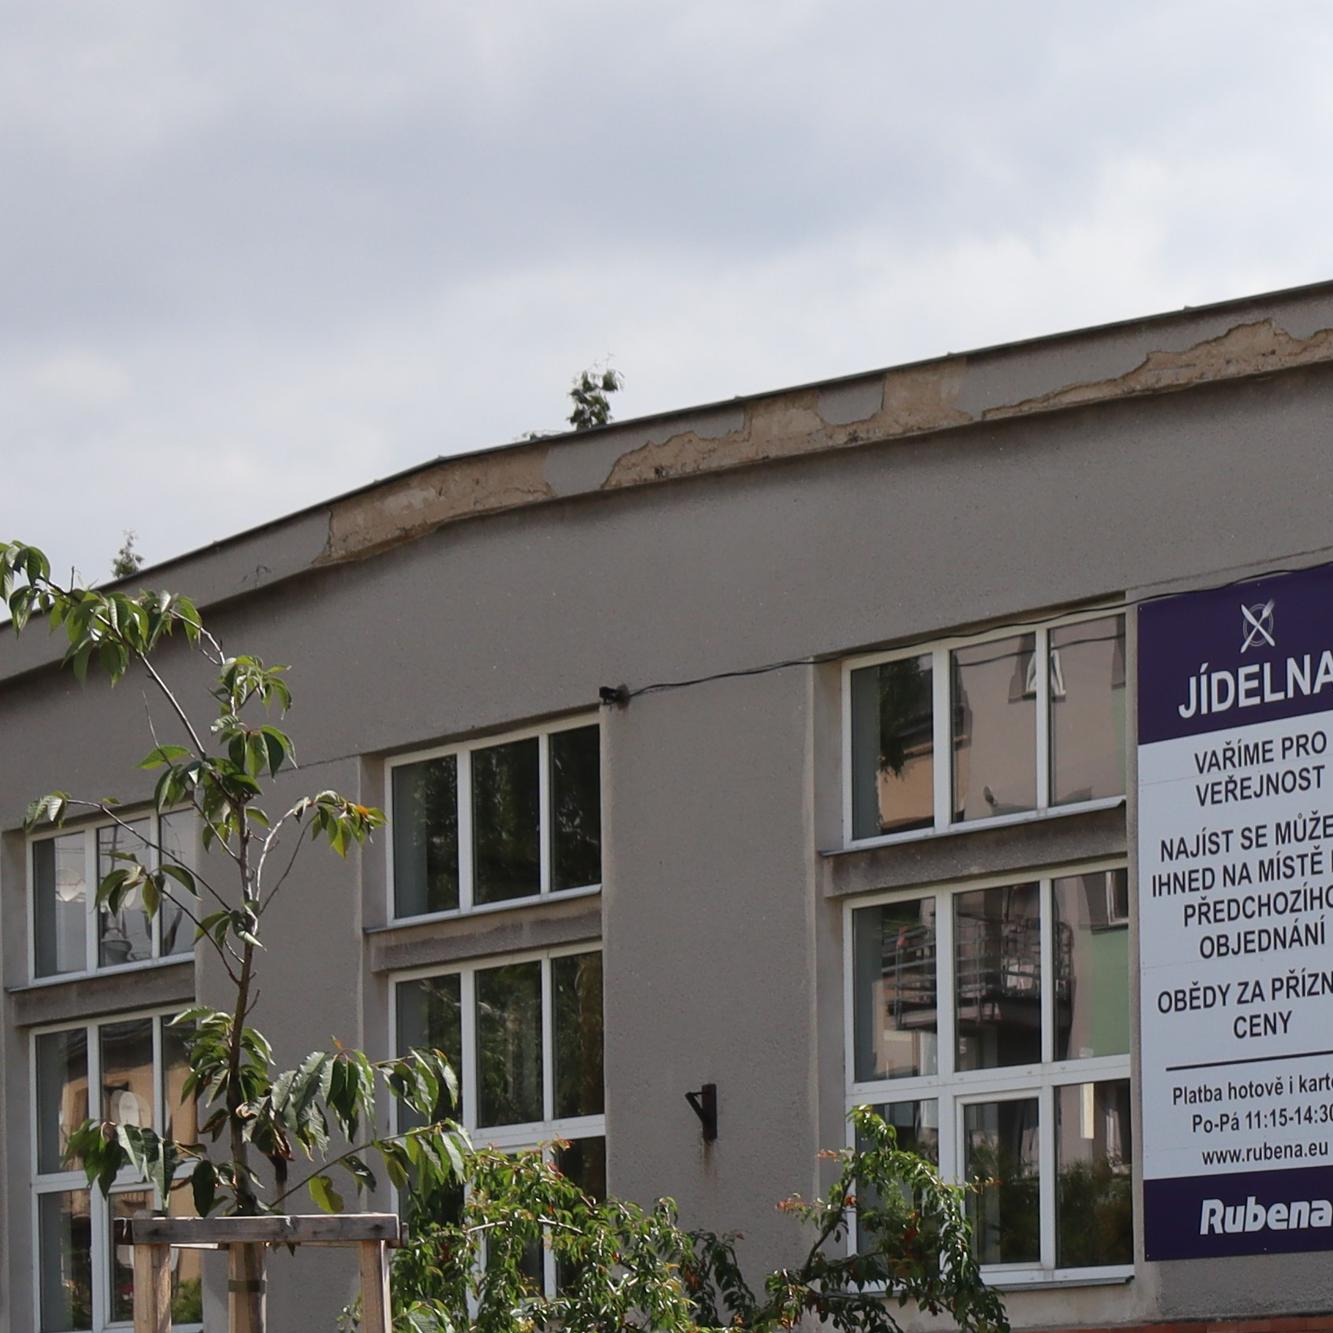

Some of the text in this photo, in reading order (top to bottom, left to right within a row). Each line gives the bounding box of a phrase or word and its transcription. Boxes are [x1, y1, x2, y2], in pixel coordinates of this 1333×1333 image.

[1194, 730, 1327, 775] VAŘÍME PRO
[1194, 763, 1327, 808] VEŘEJNOST
[1160, 826, 1234, 863] NAJÍST
[1240, 824, 1268, 851] SE
[1152, 867, 1216, 901] IHNED
[1222, 861, 1253, 888] NA
[1258, 844, 1324, 883] MÍSTĚ
[1198, 914, 1327, 961] OBJEDNÁNÍ
[1157, 980, 1231, 1014] OBĚDY
[1236, 979, 1266, 1005] ZA
[1233, 1010, 1293, 1040] CENY
[1172, 1084, 1223, 1106] Platba
[1227, 1076, 1284, 1101] hotově
[1287, 1075, 1295, 1096] i
[1192, 1111, 1240, 1134] Po-Pá
[1201, 1141, 1329, 1166] www.rubena.eu
[1200, 1196, 1333, 1235] Rubena
